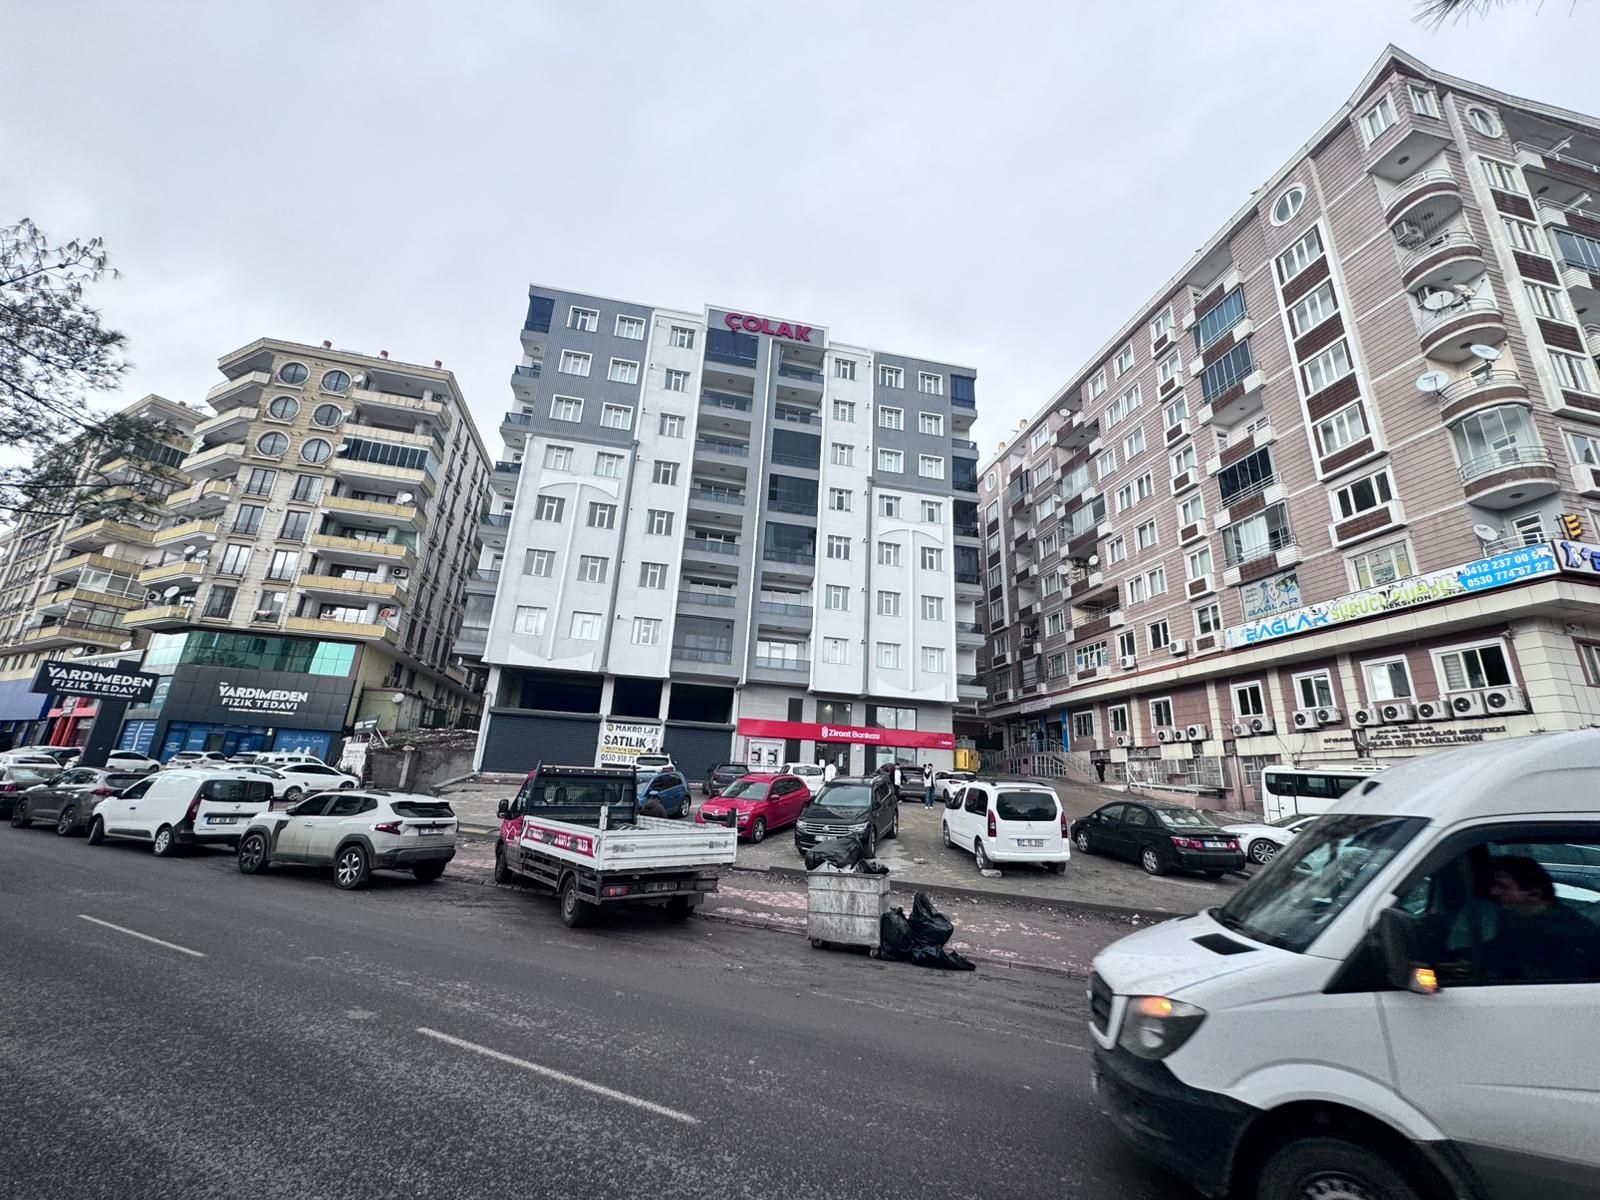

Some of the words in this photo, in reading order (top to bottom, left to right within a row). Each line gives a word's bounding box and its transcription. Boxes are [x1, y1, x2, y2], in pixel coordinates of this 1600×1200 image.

[725, 312, 812, 342] ÇOLAK
[1491, 557, 1511, 568] 237
[1467, 575, 1493, 587] 0530
[1534, 561, 1549, 572] 27
[47, 666, 154, 688] YARDIMEDEN
[93, 683, 142, 695] TEDAVİ
[219, 686, 309, 703] YARDIMEDEN
[604, 735, 647, 748] SATILIK
[828, 729, 852, 739] Ziraat
